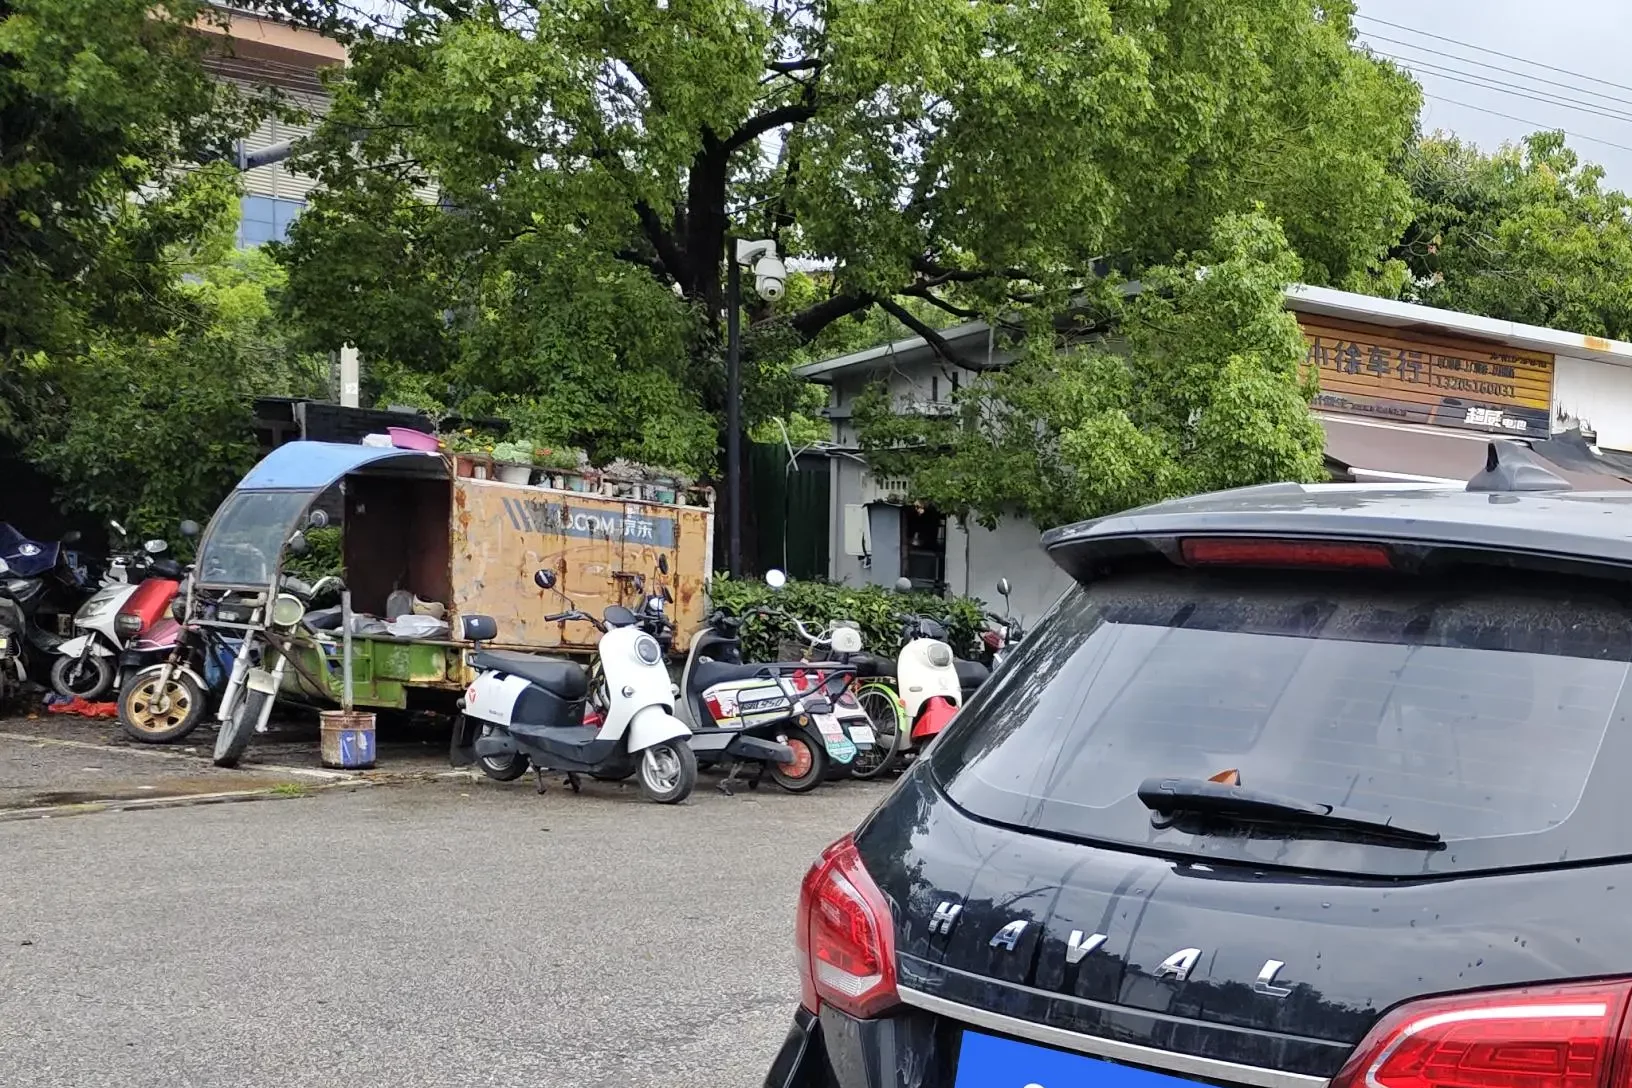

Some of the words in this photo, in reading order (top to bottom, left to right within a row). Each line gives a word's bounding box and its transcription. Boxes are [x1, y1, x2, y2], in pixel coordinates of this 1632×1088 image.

[1306, 336, 1422, 383] 小徐车行
[619, 514, 653, 540] 京东
[928, 901, 1293, 998] HAVAL
